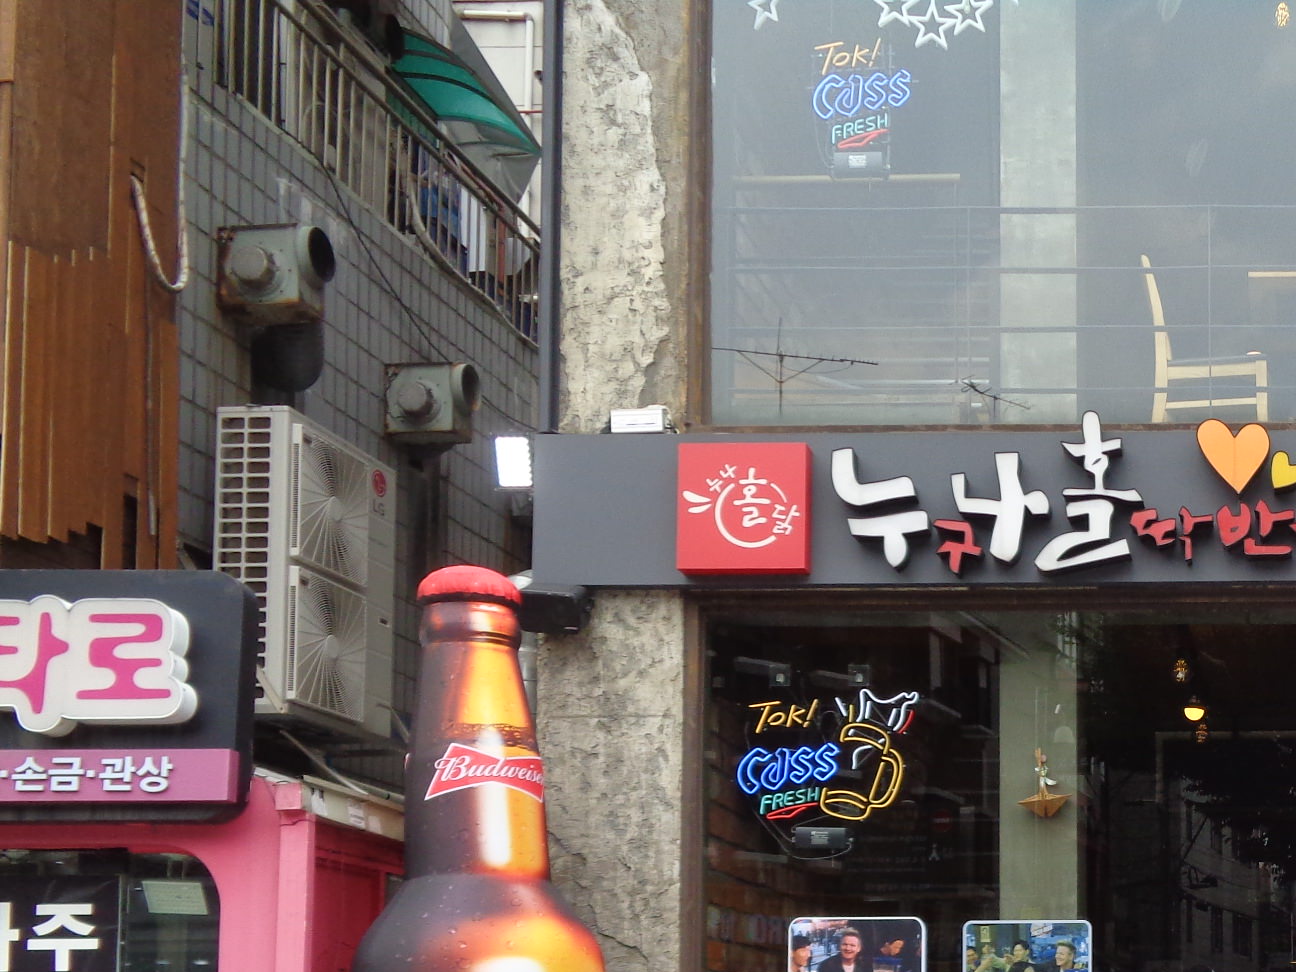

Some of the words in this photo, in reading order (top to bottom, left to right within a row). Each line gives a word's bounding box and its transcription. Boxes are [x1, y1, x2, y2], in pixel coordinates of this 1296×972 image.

[814, 38, 881, 74] Tok!
[832, 113, 888, 144] FRESH
[748, 699, 819, 734] Tok!
[759, 786, 820, 815] FRESH
